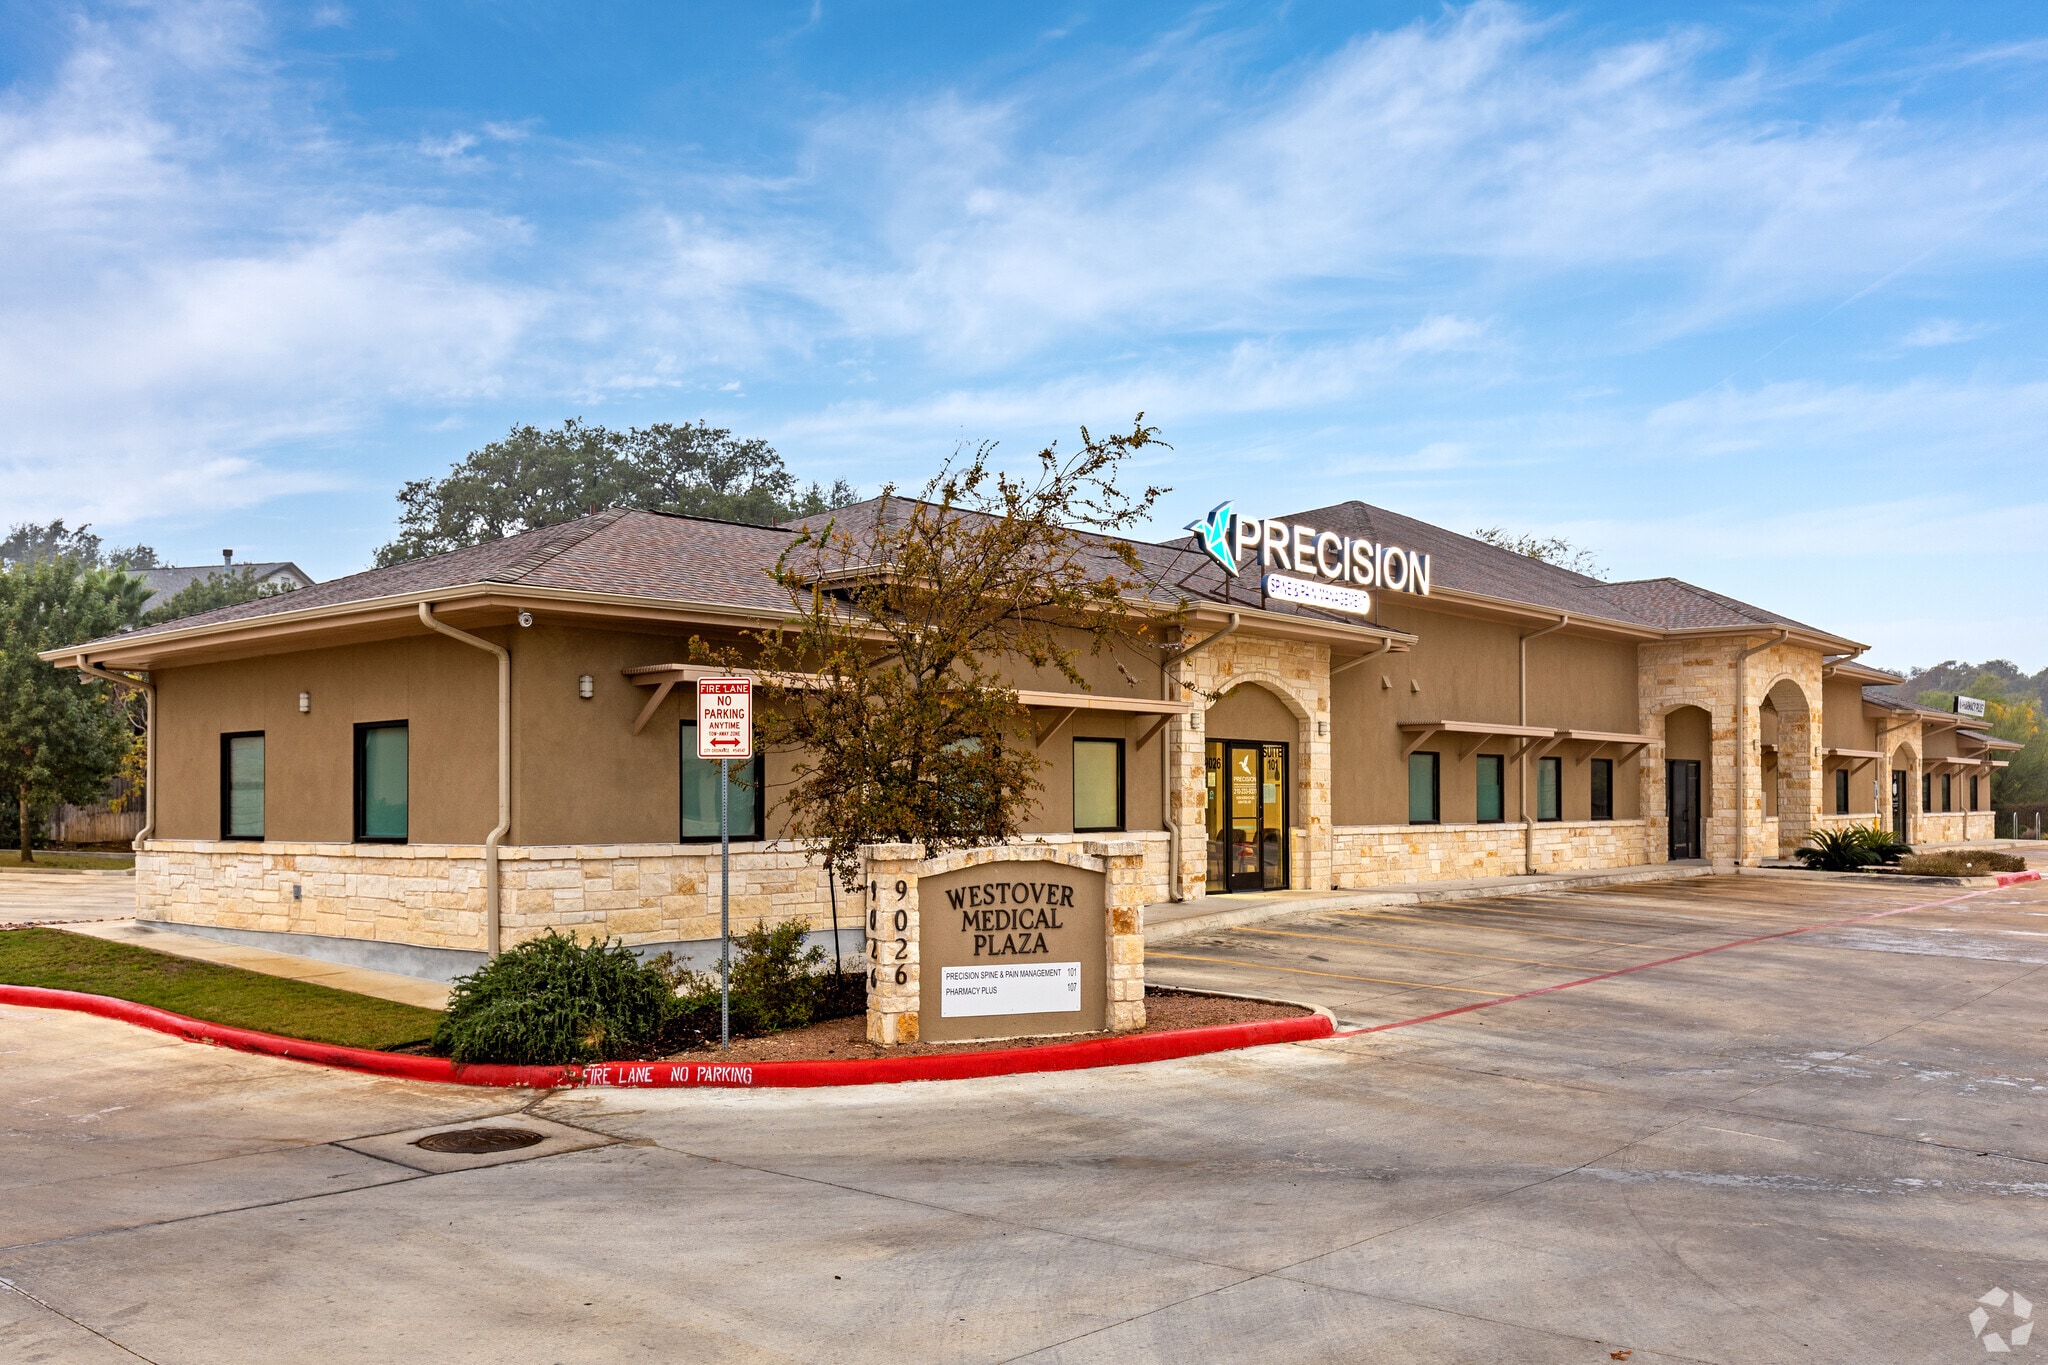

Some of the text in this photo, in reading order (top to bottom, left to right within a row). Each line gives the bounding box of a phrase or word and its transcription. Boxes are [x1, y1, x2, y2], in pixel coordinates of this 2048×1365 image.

[1231, 514, 1430, 595] PRECISION
[700, 685, 748, 693] FIRE LANE
[718, 696, 731, 706] NO
[705, 709, 744, 719] PARKING
[1263, 746, 1283, 758] SUITE
[1268, 760, 1277, 770] 101
[945, 882, 1075, 911] WESTOVER
[961, 908, 1064, 932] MEDICAL
[894, 880, 908, 985] 9026
[973, 932, 1050, 956] PLAZA
[946, 968, 1077, 981] PRECISION SPINE & PAIN MANAGEMENT 101
[945, 982, 1077, 996] PHARMACY PLUS 107
[582, 1065, 753, 1085] FIRE LANE NO PARKING
